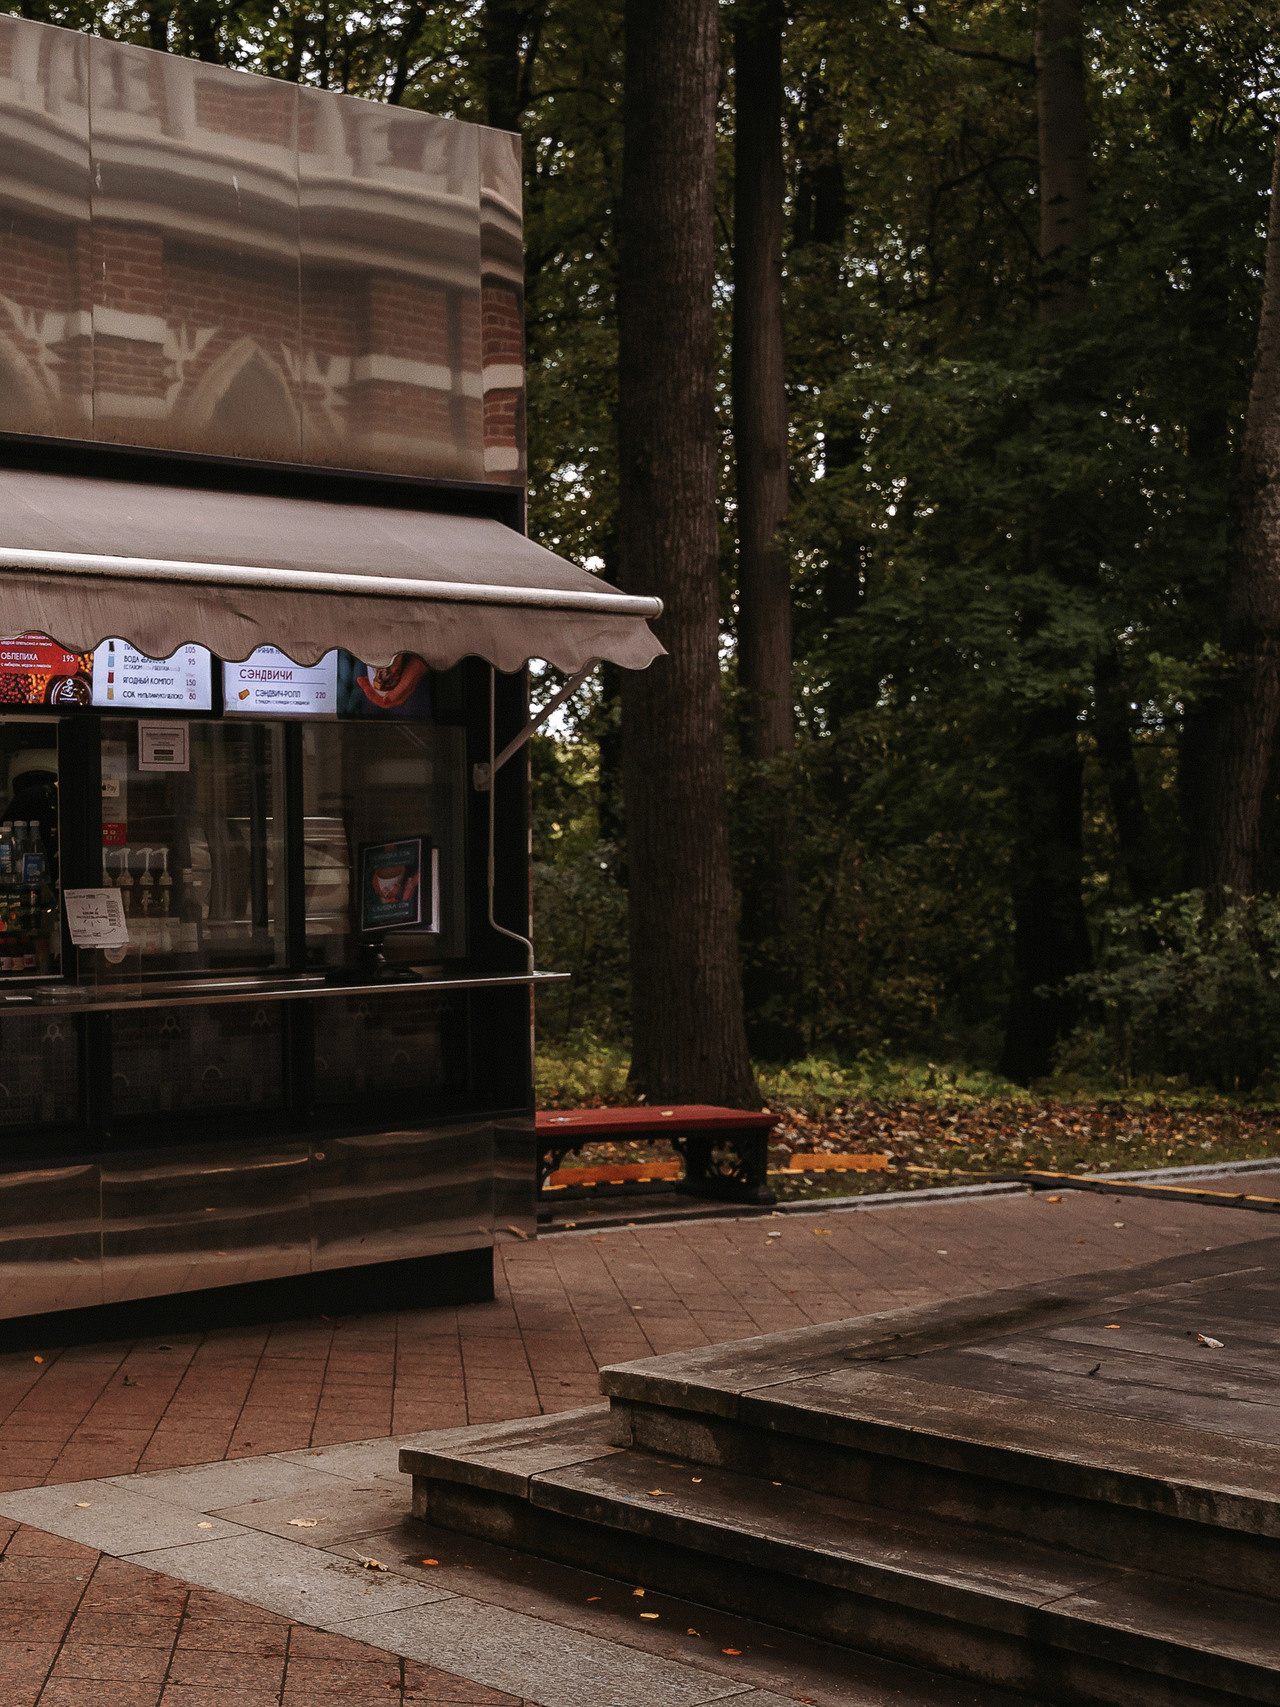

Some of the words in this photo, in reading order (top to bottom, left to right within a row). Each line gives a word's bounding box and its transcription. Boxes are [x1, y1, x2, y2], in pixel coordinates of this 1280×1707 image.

[185, 646, 196, 654] 105
[0, 651, 38, 660] ОБЛЕПИХА
[62, 654, 75, 662] 195
[124, 655, 139, 663] ВОДА
[188, 658, 196, 666] 95
[239, 669, 293, 681] СЭНДВИЧИ
[123, 676, 149, 685] ЯГОДНЫЙ
[150, 677, 174, 685] КОМПОТ
[122, 690, 135, 698] СОК
[188, 692, 197, 700] 80
[255, 689, 301, 697] СЭНДВИЧ-РОЛЛ
[315, 691, 326, 699] 220
